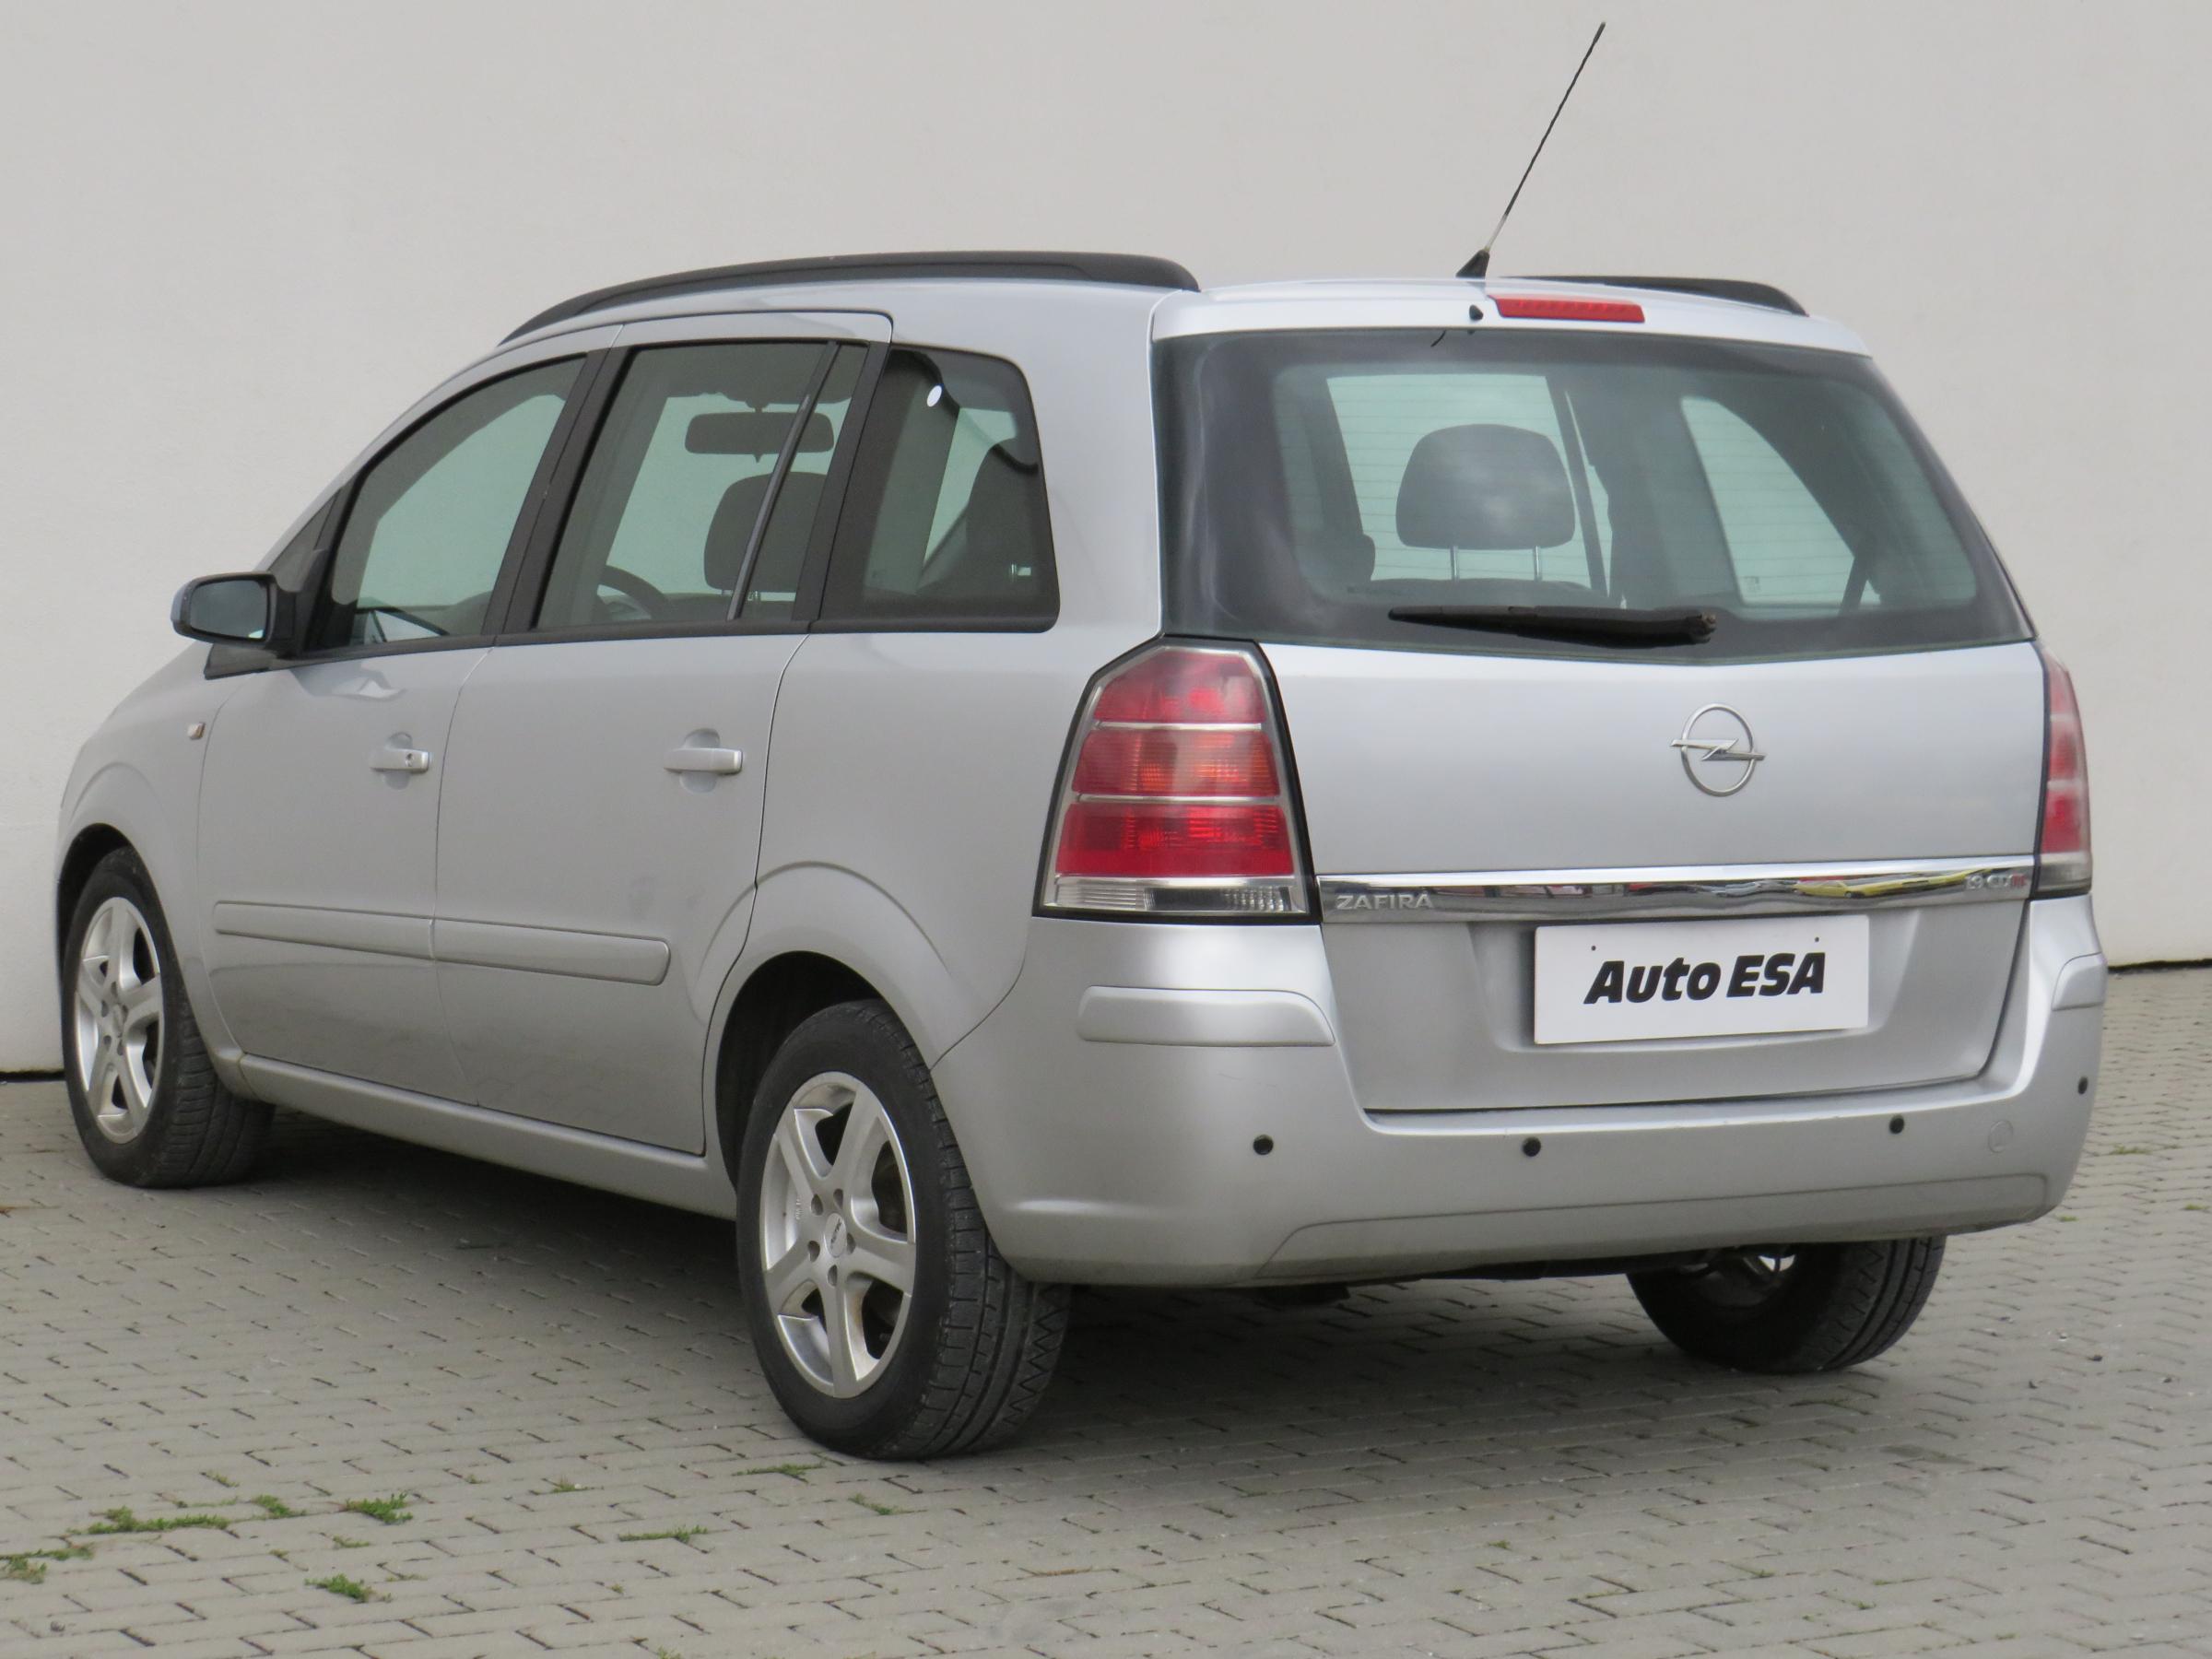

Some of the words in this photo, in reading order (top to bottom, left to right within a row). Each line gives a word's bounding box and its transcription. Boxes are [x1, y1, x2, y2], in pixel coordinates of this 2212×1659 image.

[1335, 891, 1434, 911] ZAFIRA
[1583, 957, 1722, 1005] Auto
[1725, 951, 1826, 998] ESA
